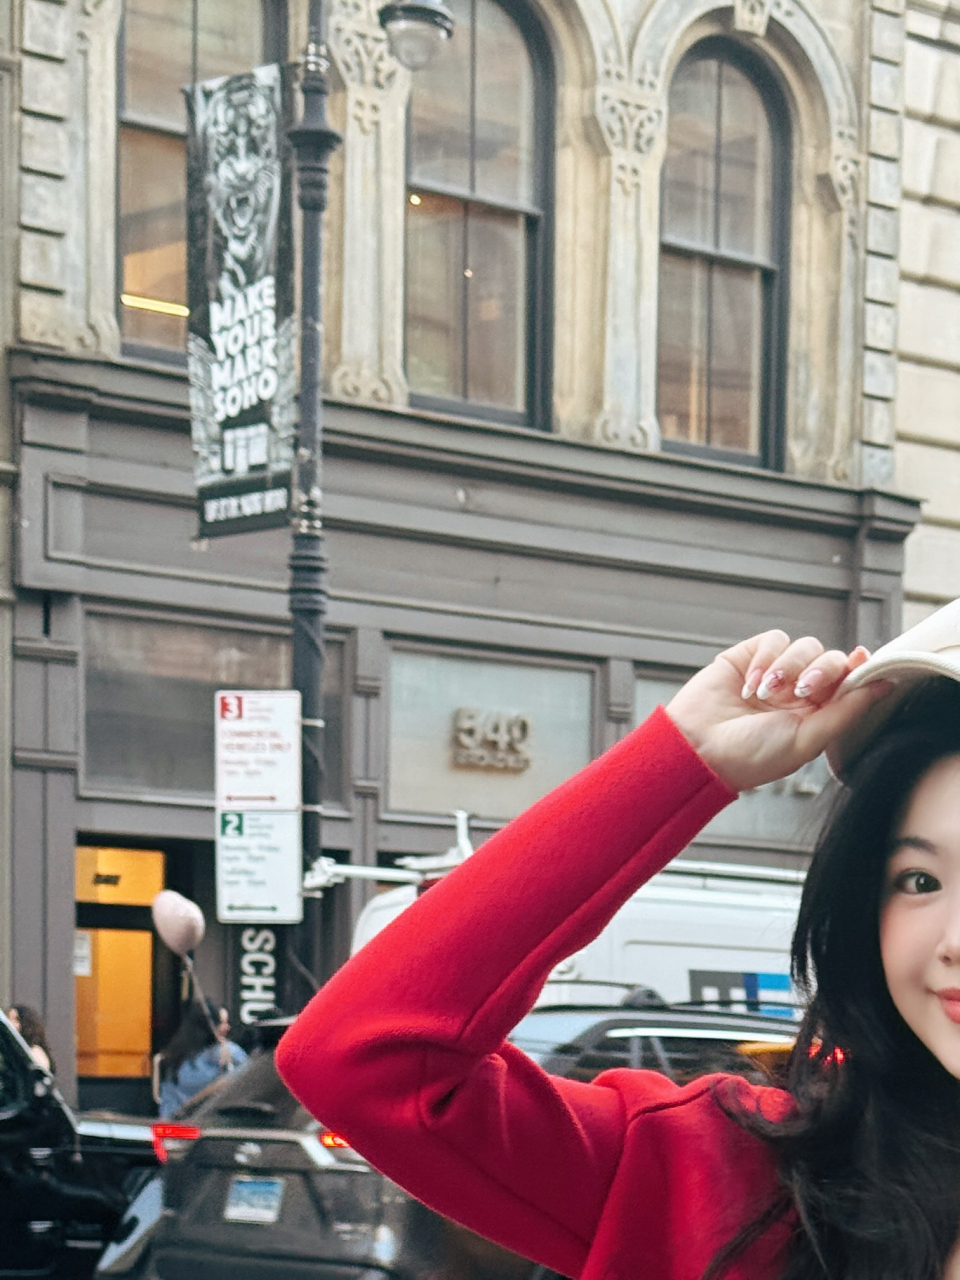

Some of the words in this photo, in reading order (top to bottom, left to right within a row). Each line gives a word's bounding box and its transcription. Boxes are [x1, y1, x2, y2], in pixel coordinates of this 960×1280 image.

[209, 275, 276, 332] MAKE
[210, 308, 276, 361] YOUR
[211, 336, 277, 391] MARK
[214, 366, 278, 422] SOHO
[223, 696, 240, 719] 3
[223, 813, 240, 836] 2
